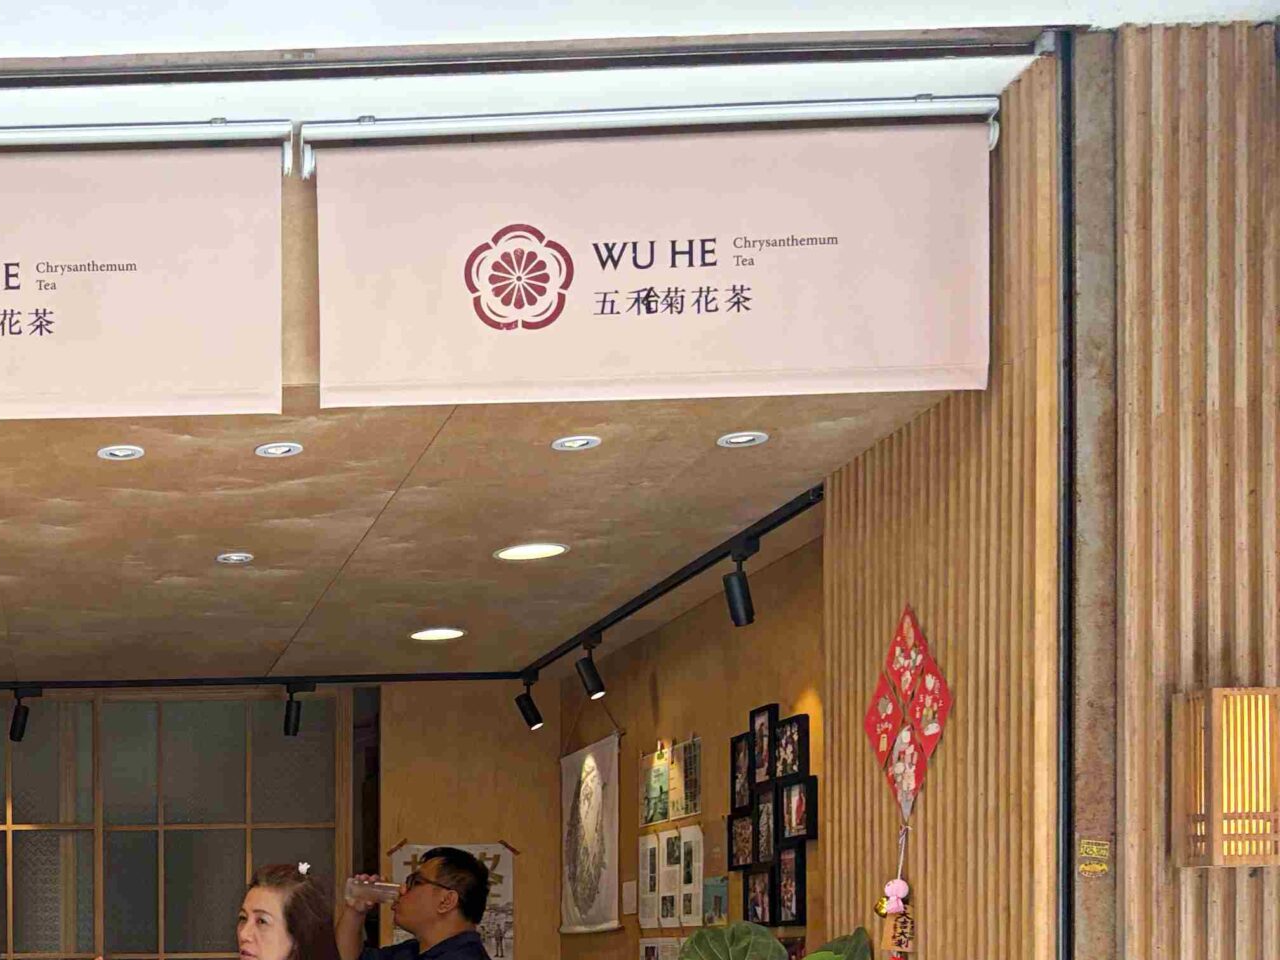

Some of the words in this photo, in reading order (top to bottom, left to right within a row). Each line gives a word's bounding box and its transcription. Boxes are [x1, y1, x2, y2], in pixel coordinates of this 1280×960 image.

[733, 235, 838, 251] Chrysanthemum
[592, 240, 656, 271] WU
[670, 238, 717, 268] HE
[733, 255, 755, 267] Tea
[35, 260, 137, 275] Chrysanthemum
[36, 280, 57, 291] Tea
